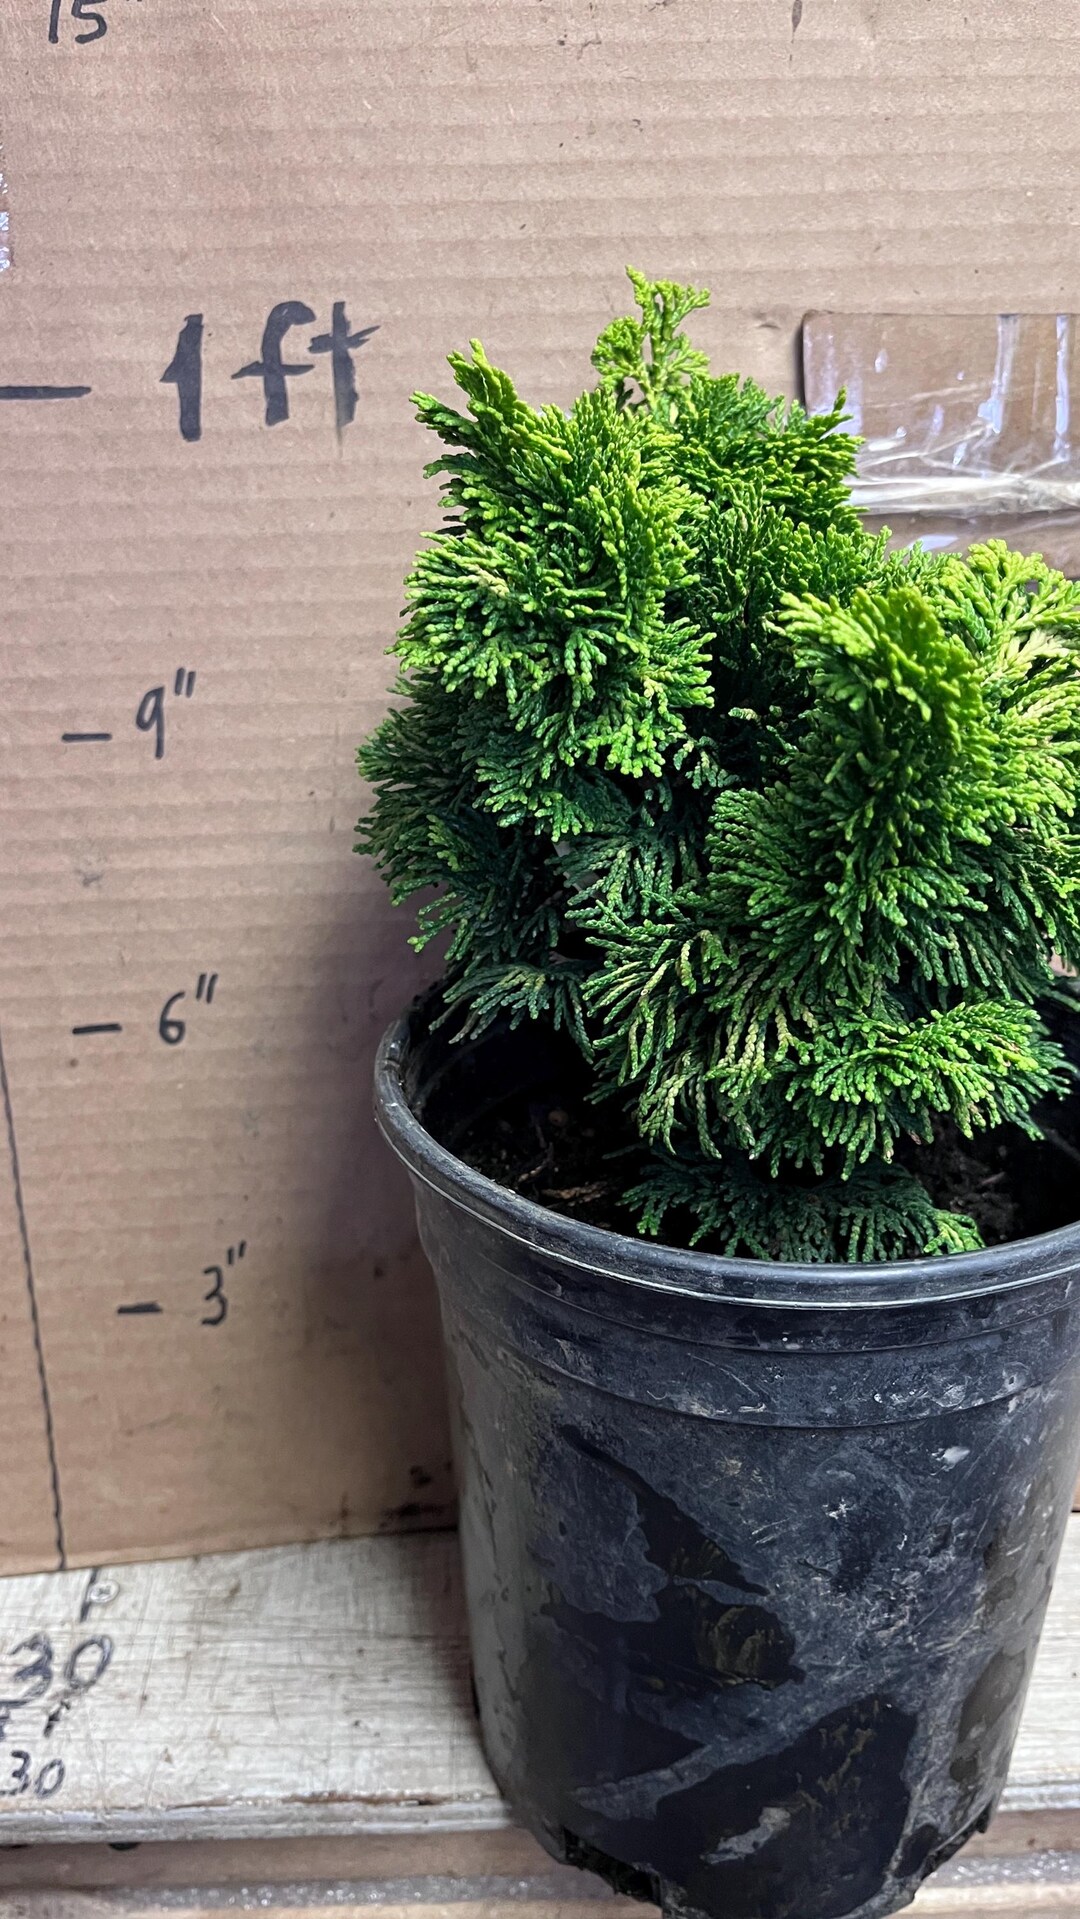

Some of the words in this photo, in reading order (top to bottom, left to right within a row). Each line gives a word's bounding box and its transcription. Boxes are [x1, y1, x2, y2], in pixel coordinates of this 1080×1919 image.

[160, 313, 204, 441] 1
[231, 300, 380, 427] ft
[136, 667, 196, 759] 9"
[159, 973, 218, 1045] 6"
[201, 1240, 247, 1326] 3"
